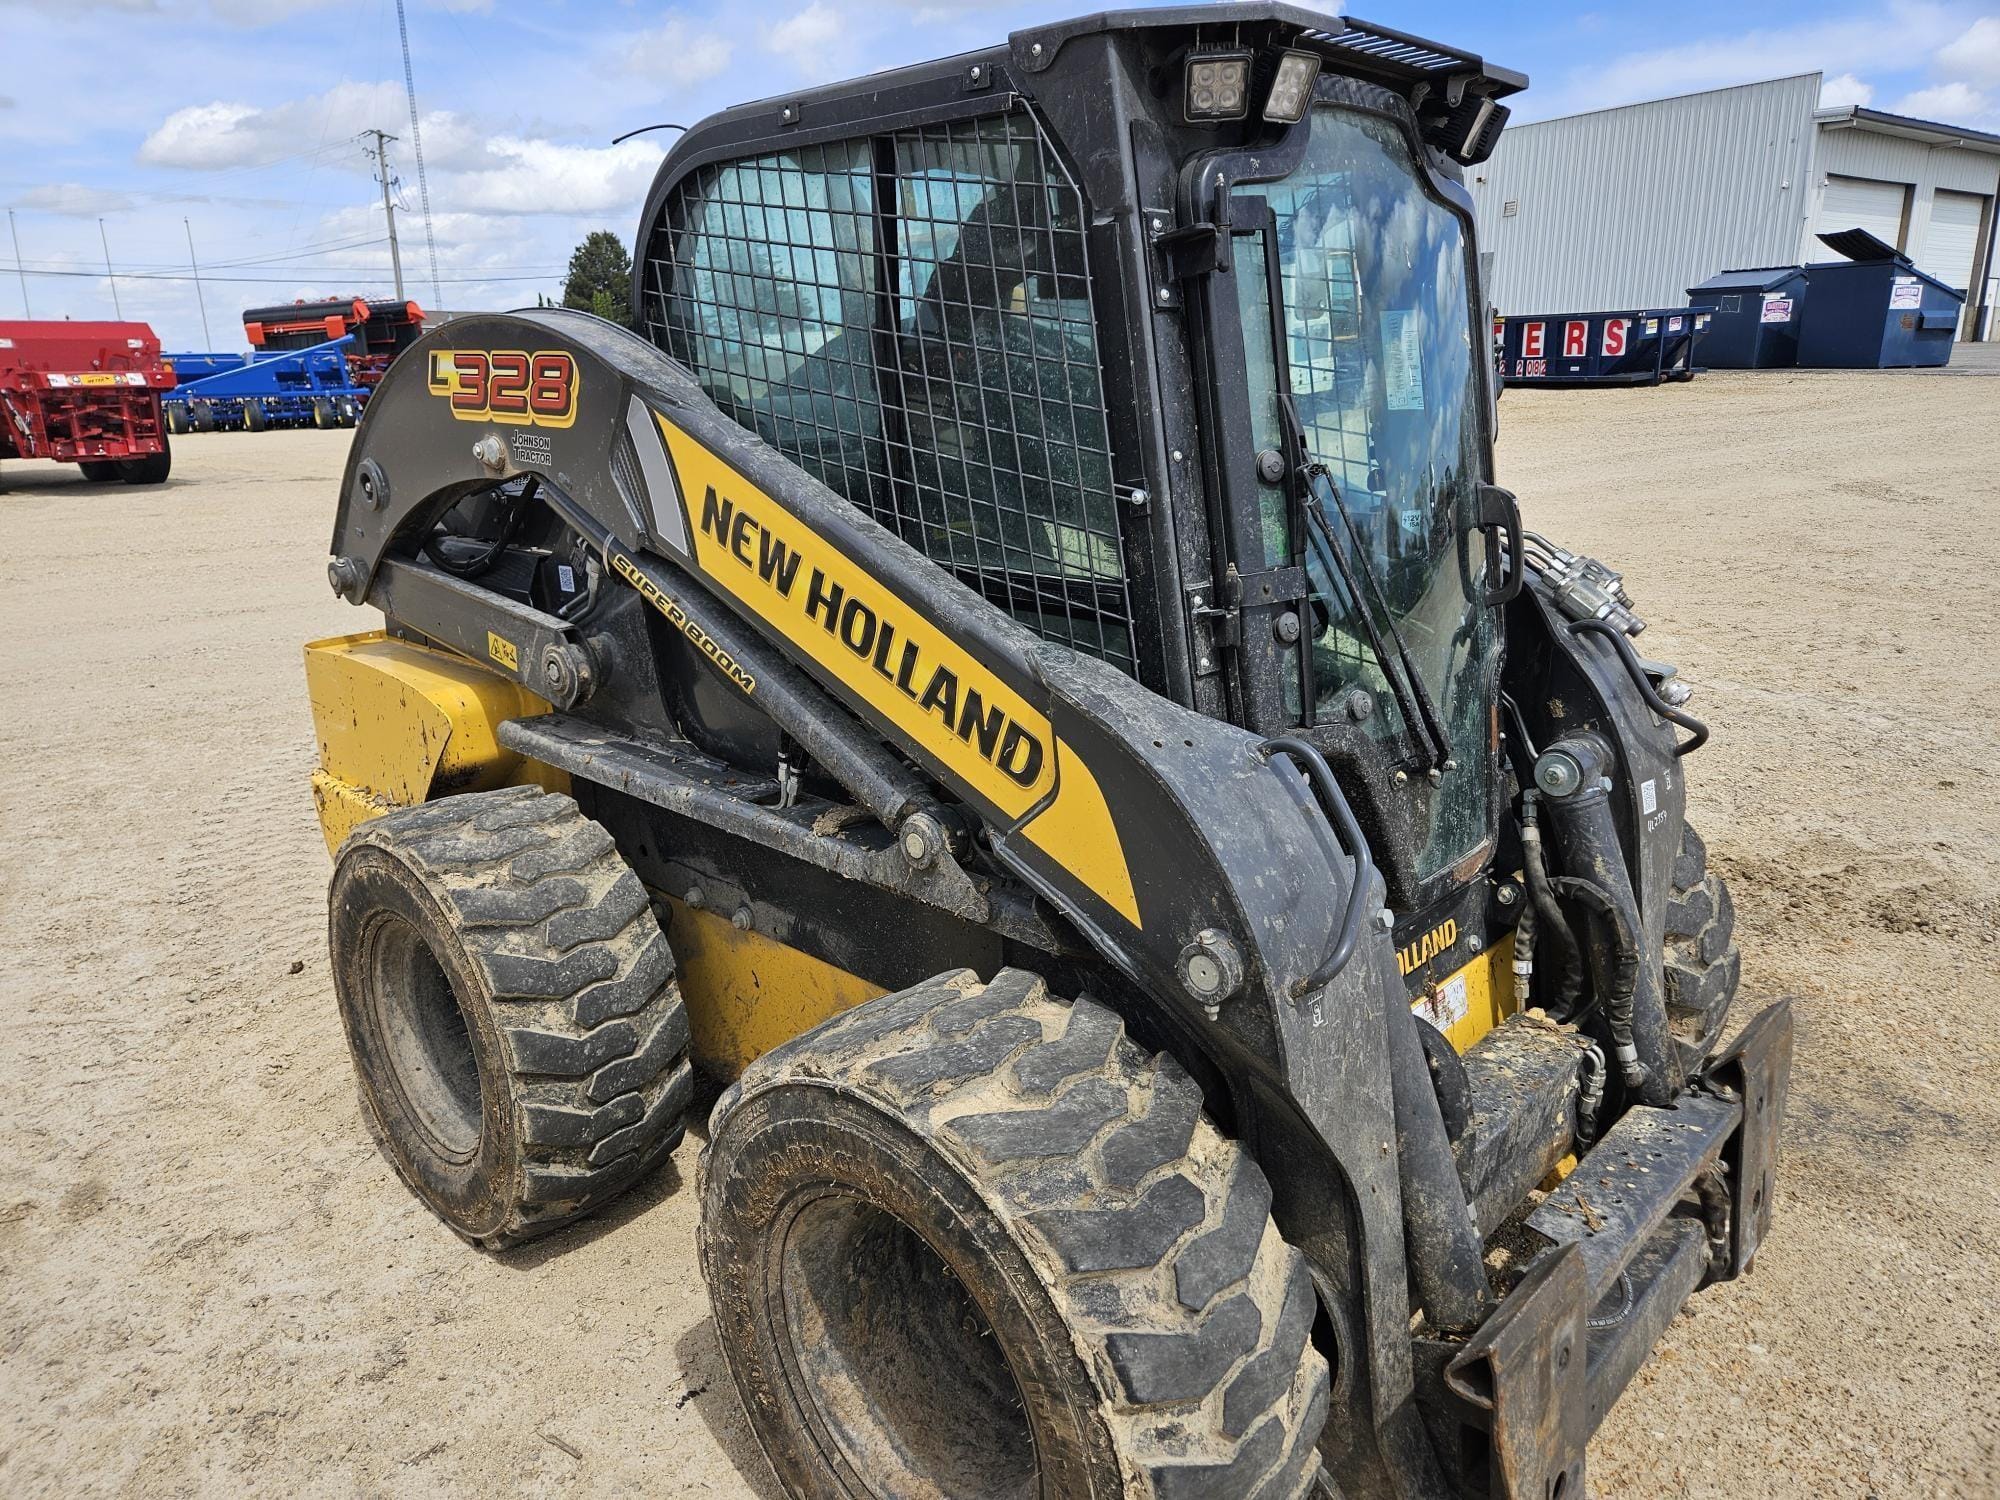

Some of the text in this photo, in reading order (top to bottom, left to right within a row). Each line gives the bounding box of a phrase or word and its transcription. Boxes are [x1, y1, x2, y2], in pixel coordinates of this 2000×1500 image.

[429, 351, 577, 425] L328
[511, 429, 550, 449] JOHNSON
[514, 446, 551, 465] TRACTOR
[613, 554, 756, 695] SUPER BOOM
[700, 484, 1044, 789] NEW HOLLAND
